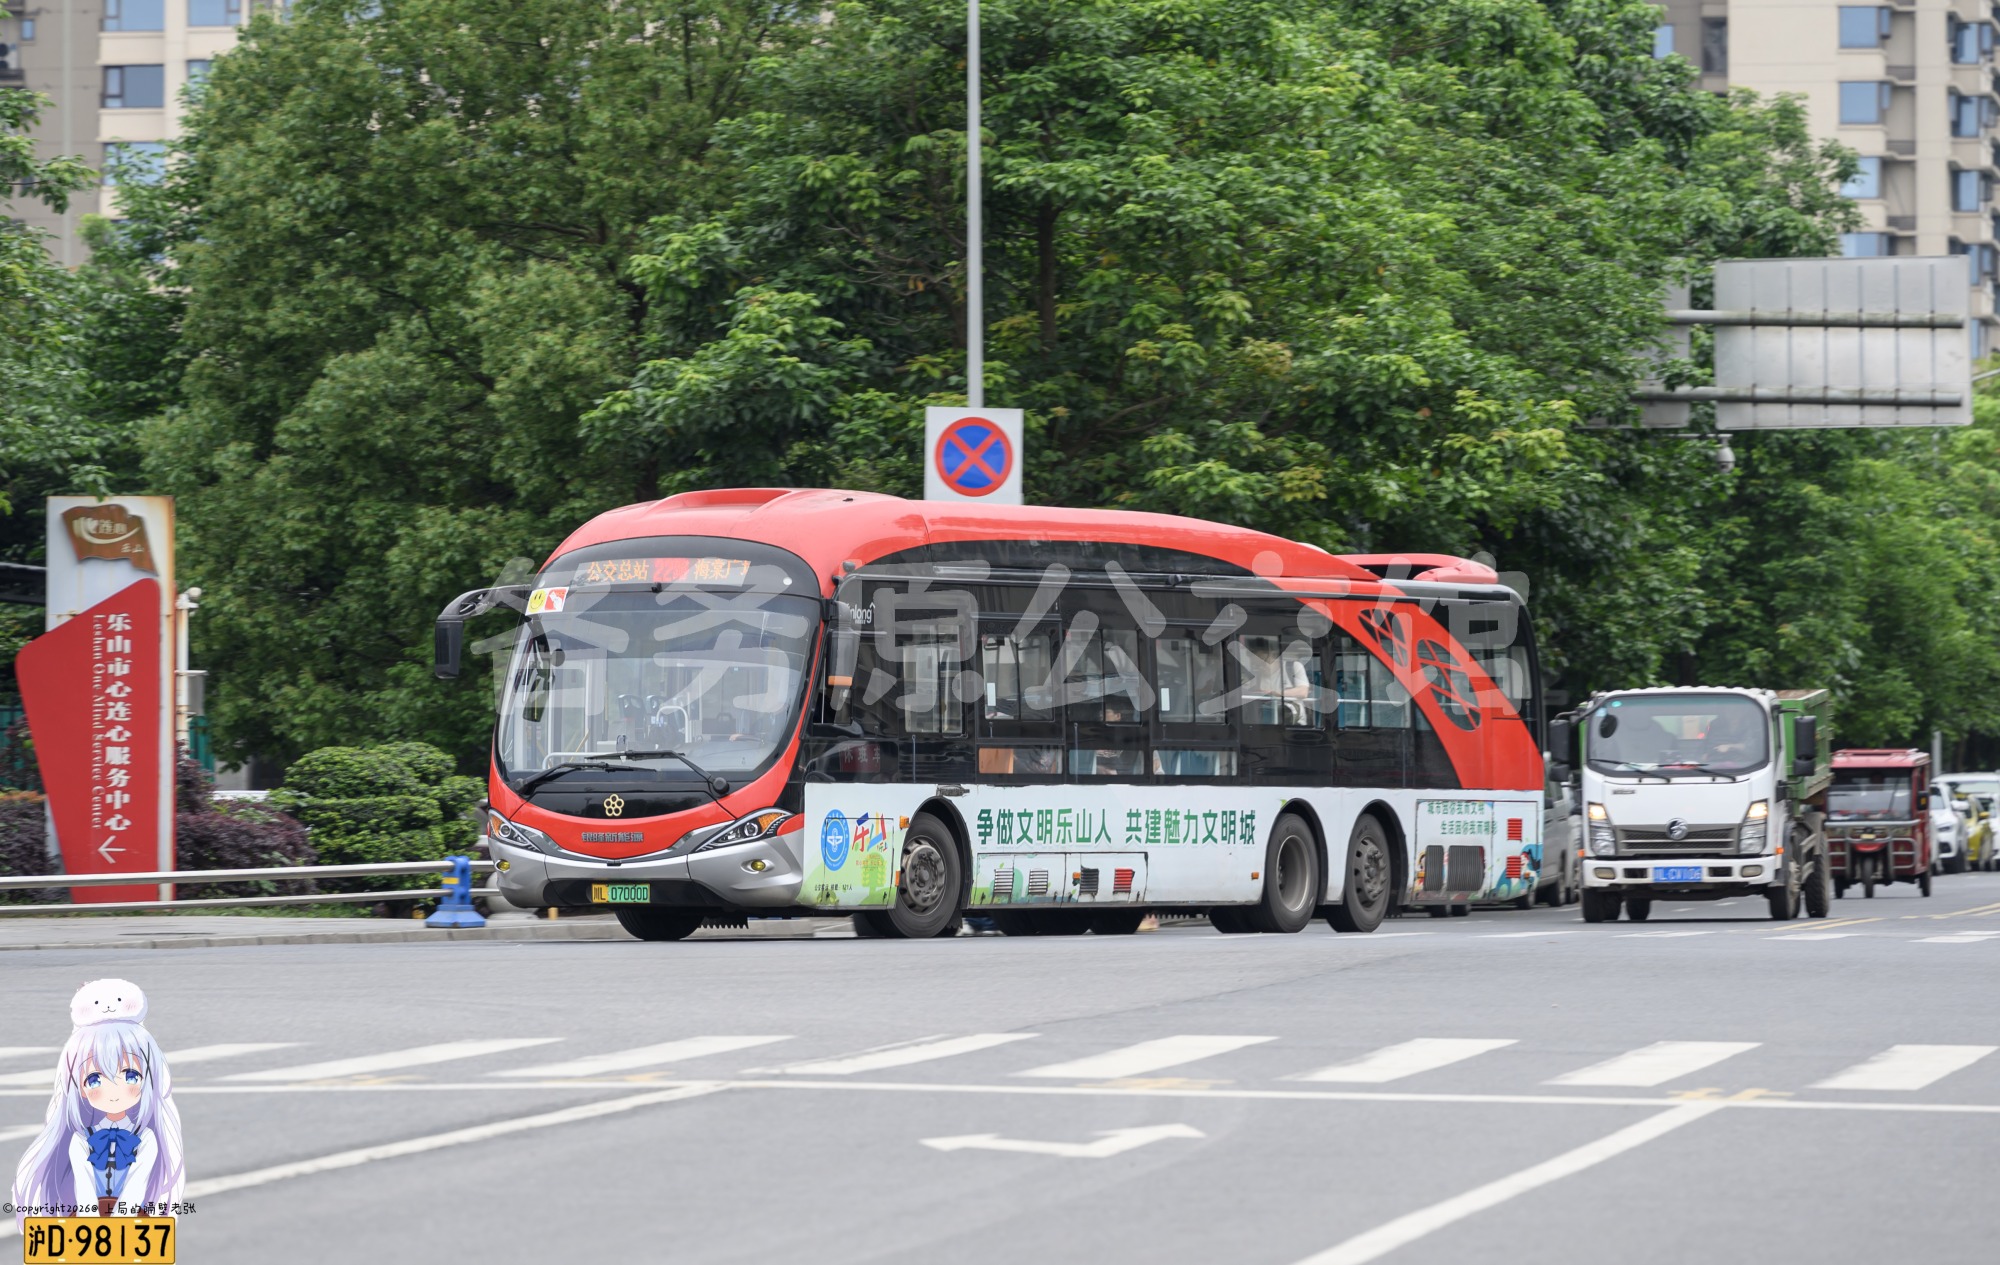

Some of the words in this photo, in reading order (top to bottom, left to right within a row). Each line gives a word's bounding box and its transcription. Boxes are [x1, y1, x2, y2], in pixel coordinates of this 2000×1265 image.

[587, 560, 650, 582] 公交总站
[92, 614, 106, 660] Leshan
[92, 663, 106, 690] One
[92, 695, 106, 729] Mind
[104, 612, 133, 831] 乐山市心连心服务中心
[92, 734, 105, 781] Service
[91, 786, 105, 830] Center
[977, 808, 1112, 845] 争做文明乐山人
[1125, 808, 1256, 845] 共建魅力文明城
[611, 886, 649, 901] 07000D
